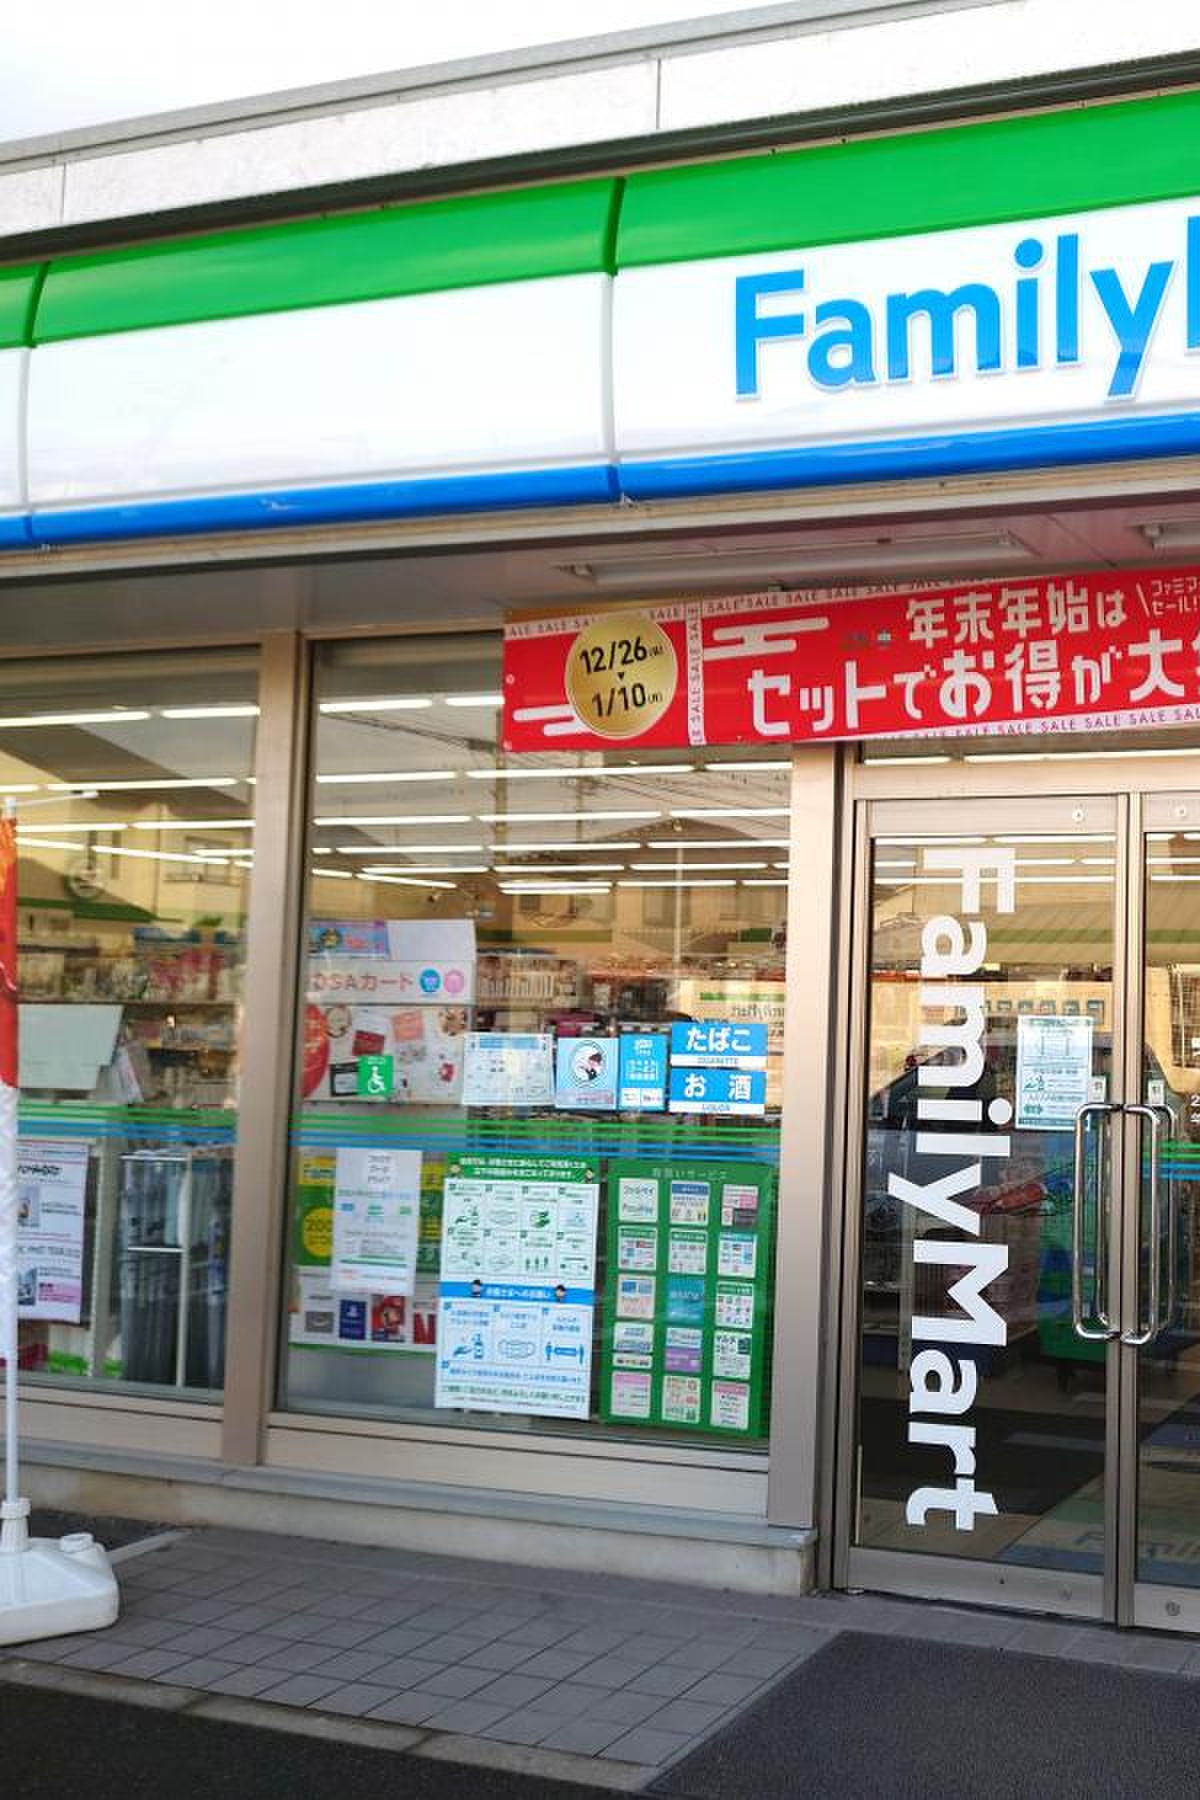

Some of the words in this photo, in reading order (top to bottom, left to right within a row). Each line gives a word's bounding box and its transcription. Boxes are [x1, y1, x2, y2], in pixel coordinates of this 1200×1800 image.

[706, 598, 746, 614] SALE
[747, 593, 779, 607] SALE
[906, 578, 1128, 650] 年末年始は
[997, 724, 1034, 736] SALE
[1040, 718, 1076, 732] SALE
[1085, 715, 1122, 729] SALE
[1129, 711, 1168, 726] SALE
[685, 1026, 752, 1053] たばこ
[684, 1073, 753, 1101] お酒
[887, 847, 1017, 1532] FamilyMart
